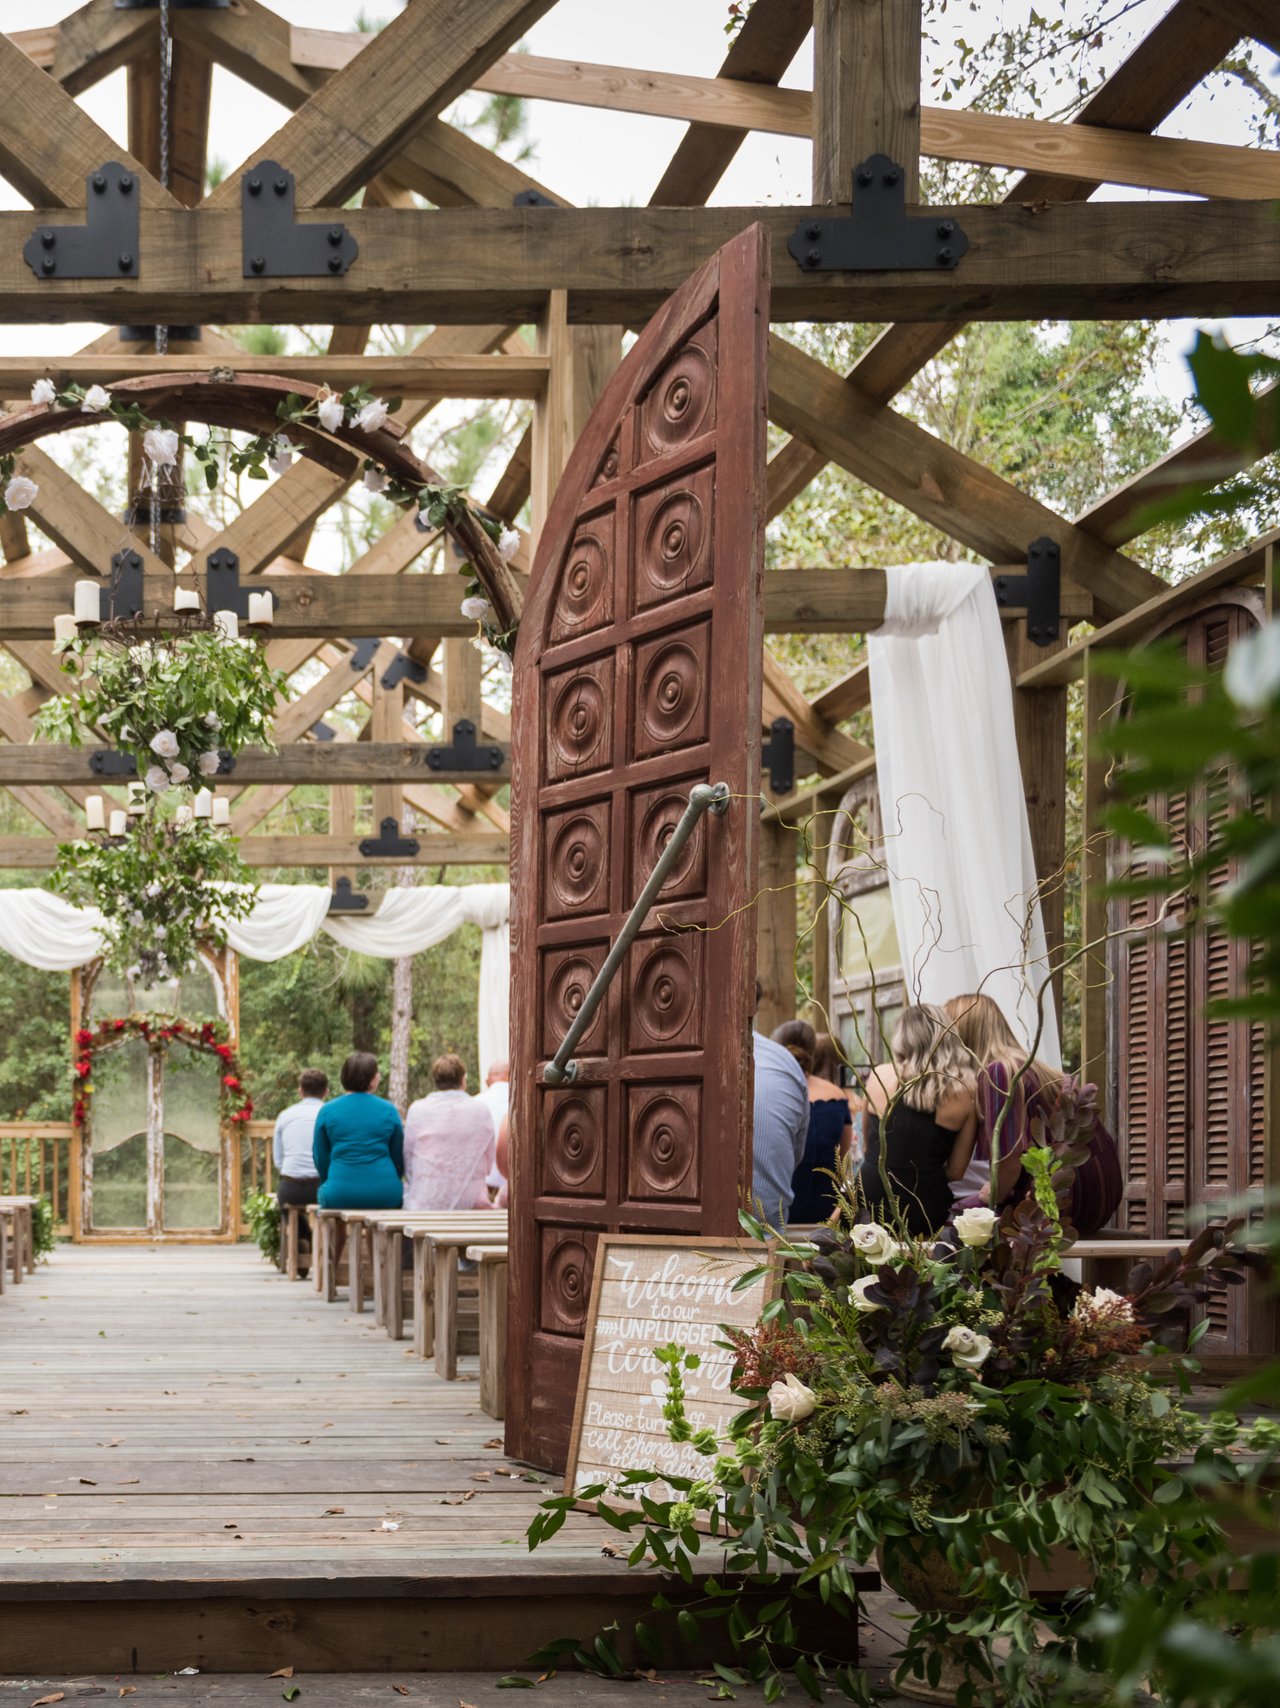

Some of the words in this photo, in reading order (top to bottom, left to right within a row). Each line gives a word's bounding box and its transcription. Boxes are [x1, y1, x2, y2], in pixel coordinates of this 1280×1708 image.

[608, 1254, 753, 1307] Welcome
[651, 1298, 671, 1319] to
[673, 1305, 700, 1320] our
[587, 1402, 632, 1428] Please
[585, 1429, 621, 1452] cell
